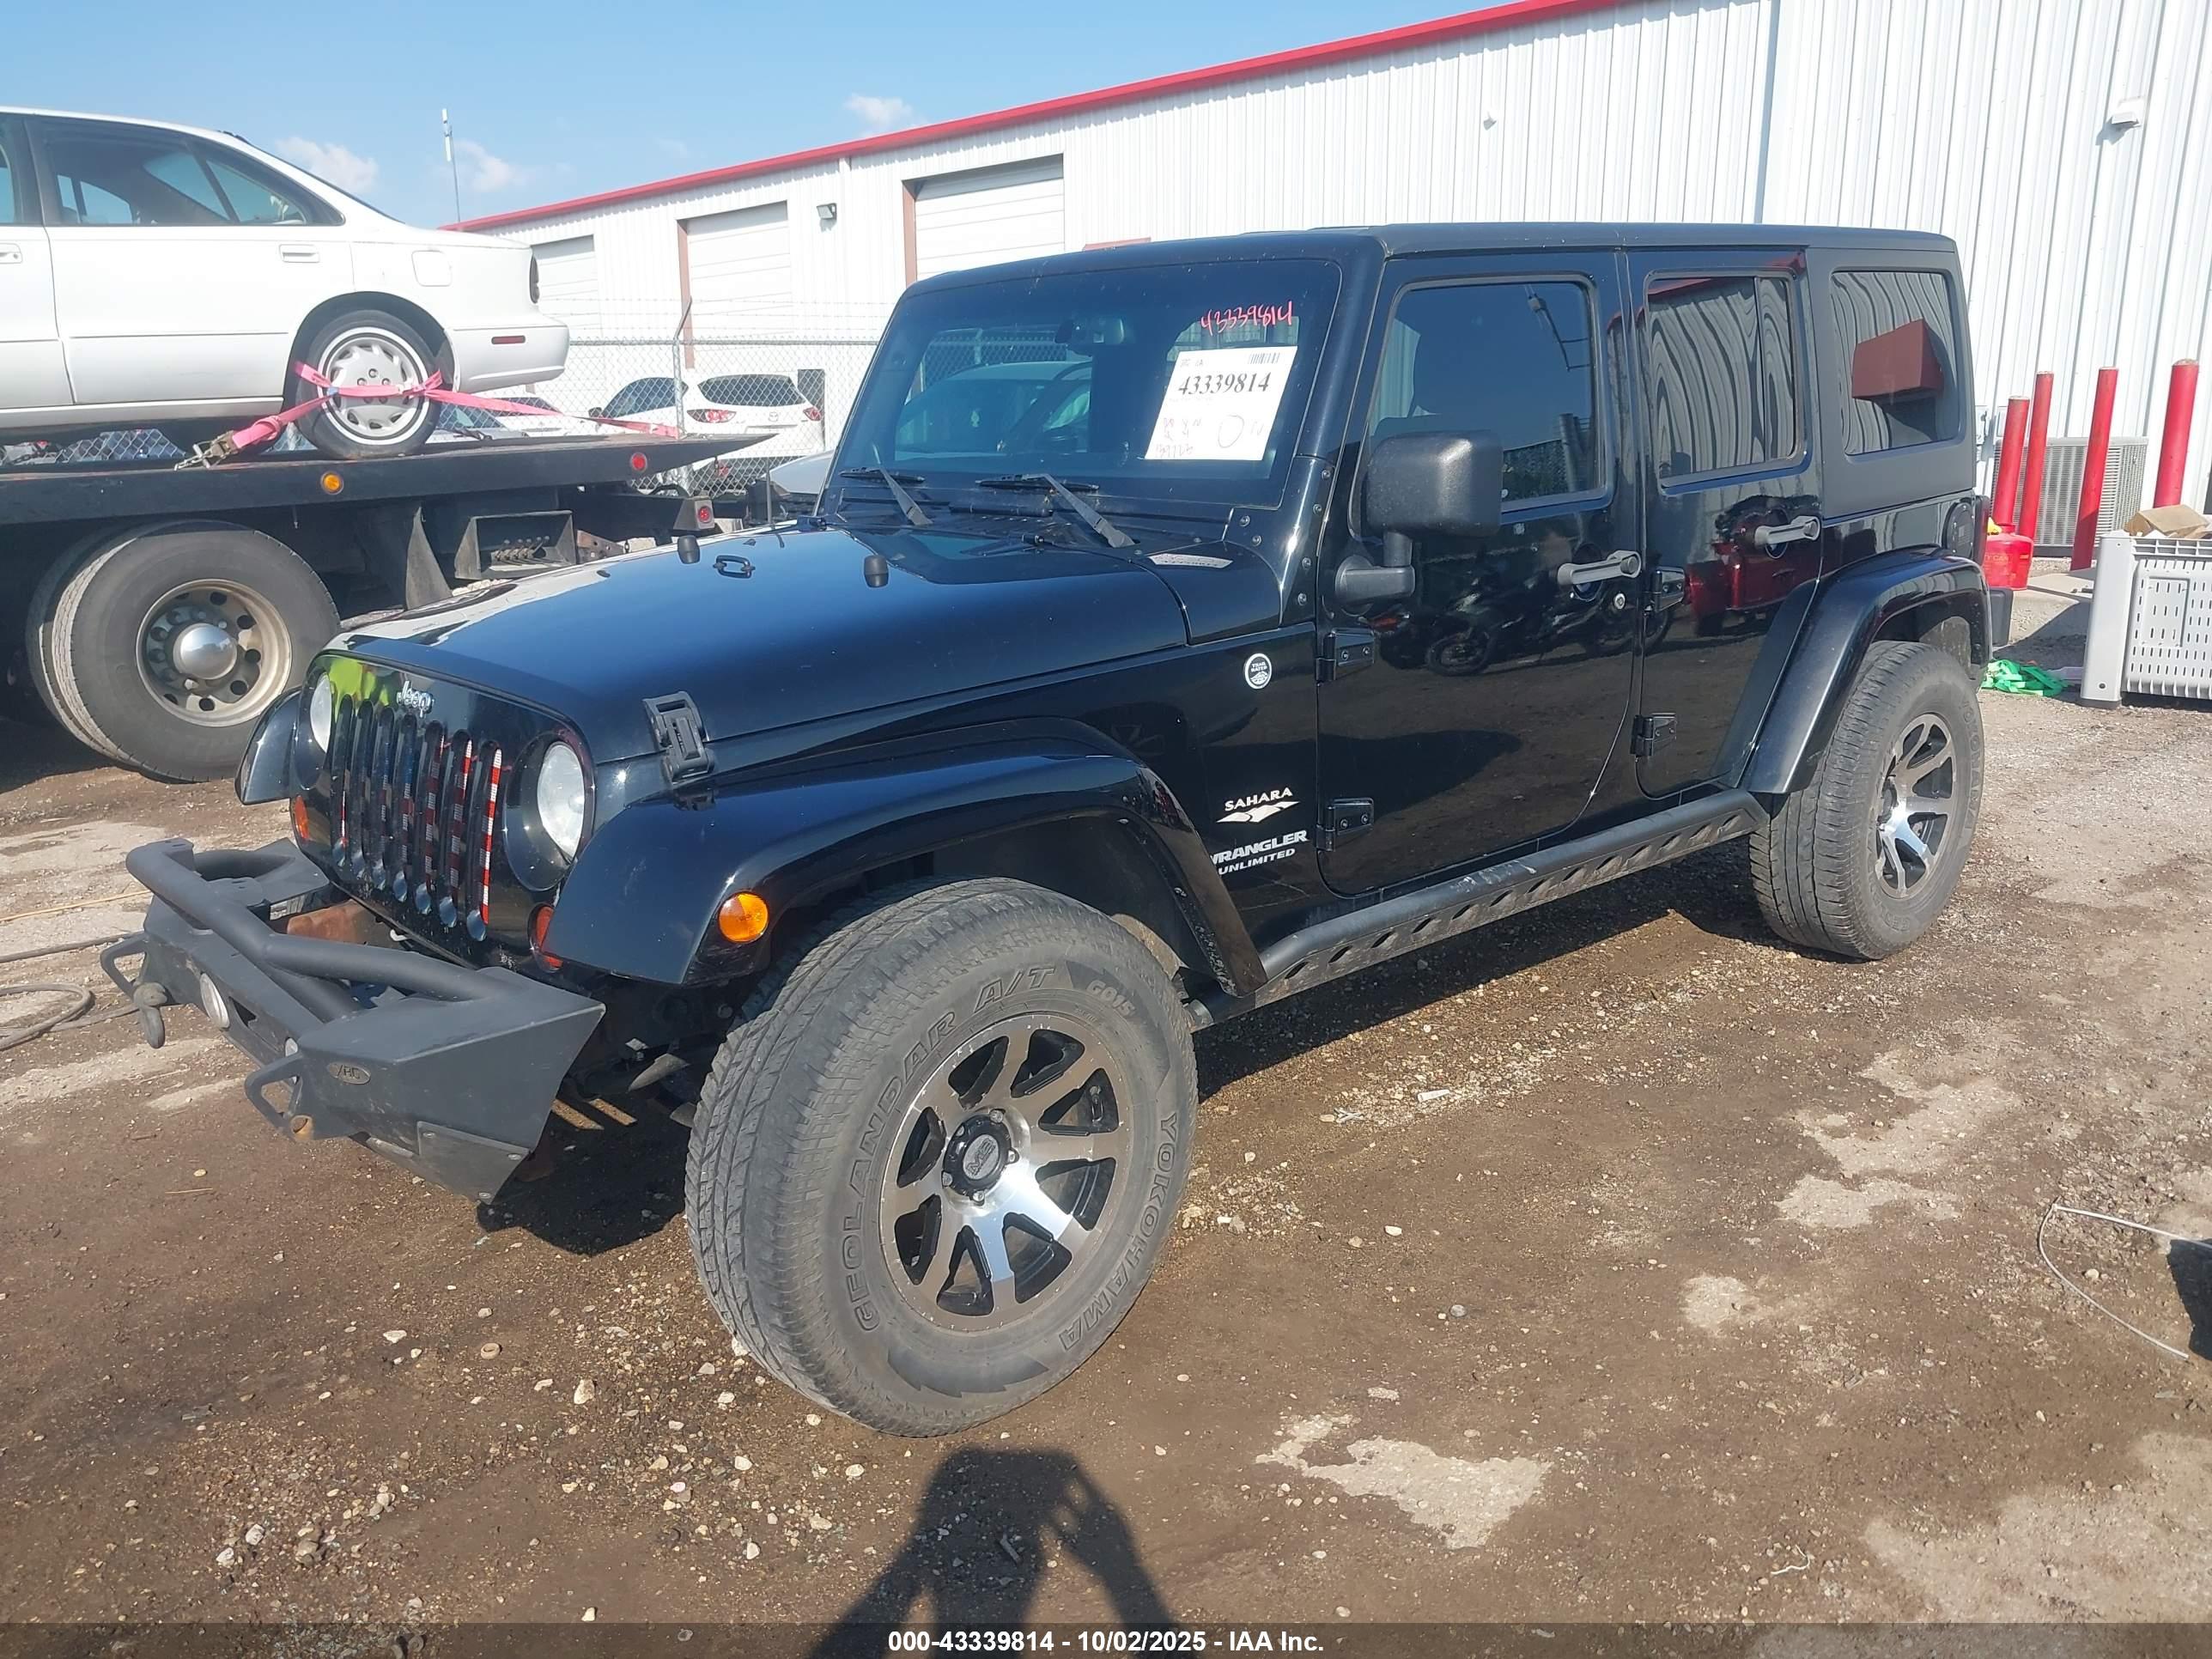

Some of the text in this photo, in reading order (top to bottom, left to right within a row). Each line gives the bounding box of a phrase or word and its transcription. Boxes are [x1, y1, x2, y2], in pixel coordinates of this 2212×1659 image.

[1200, 301, 1292, 337] 43339814
[1178, 371, 1272, 395] 43339814
[396, 680, 432, 718] Jeep
[1959, 697, 1981, 829] OOHAMA
[1224, 787, 1293, 811] SAHARA
[1218, 848, 1296, 875] UNLIMITED
[975, 967, 1056, 1011] A/T
[1058, 1112, 1177, 1352] YOKOHAMA
